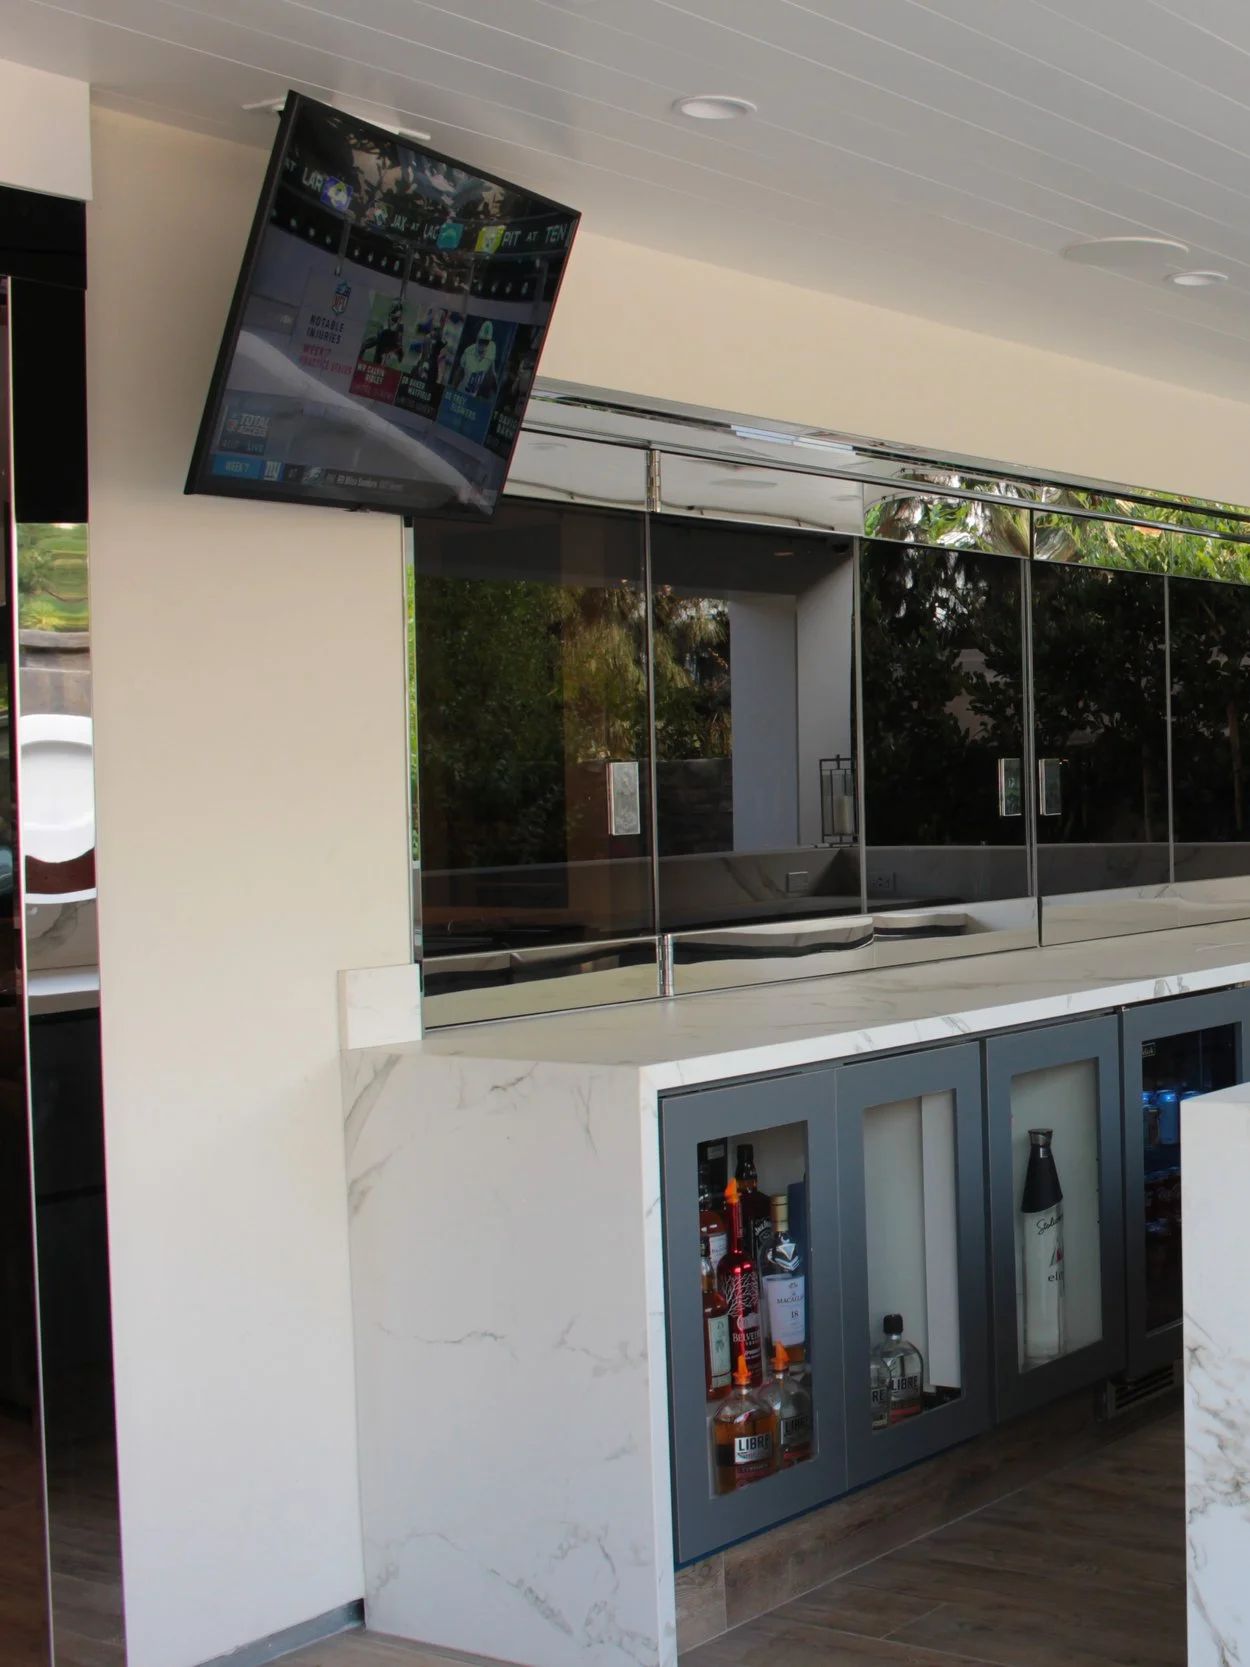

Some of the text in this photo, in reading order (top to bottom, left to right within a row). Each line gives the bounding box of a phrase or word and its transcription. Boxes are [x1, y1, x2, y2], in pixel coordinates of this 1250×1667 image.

[302, 168, 323, 192] LAR
[391, 214, 407, 232] JAX
[502, 231, 522, 247] PIT
[545, 224, 567, 242] TEN
[309, 314, 344, 332] NOTABLE
[306, 327, 341, 344] INJURIES
[240, 413, 270, 427] TOTAL
[450, 403, 476, 420] FLOWERS
[237, 425, 267, 437] ACCESS
[791, 1311, 799, 1319] 18
[891, 1375, 918, 1391] LIBRE
[738, 1434, 769, 1452] LIBRE
